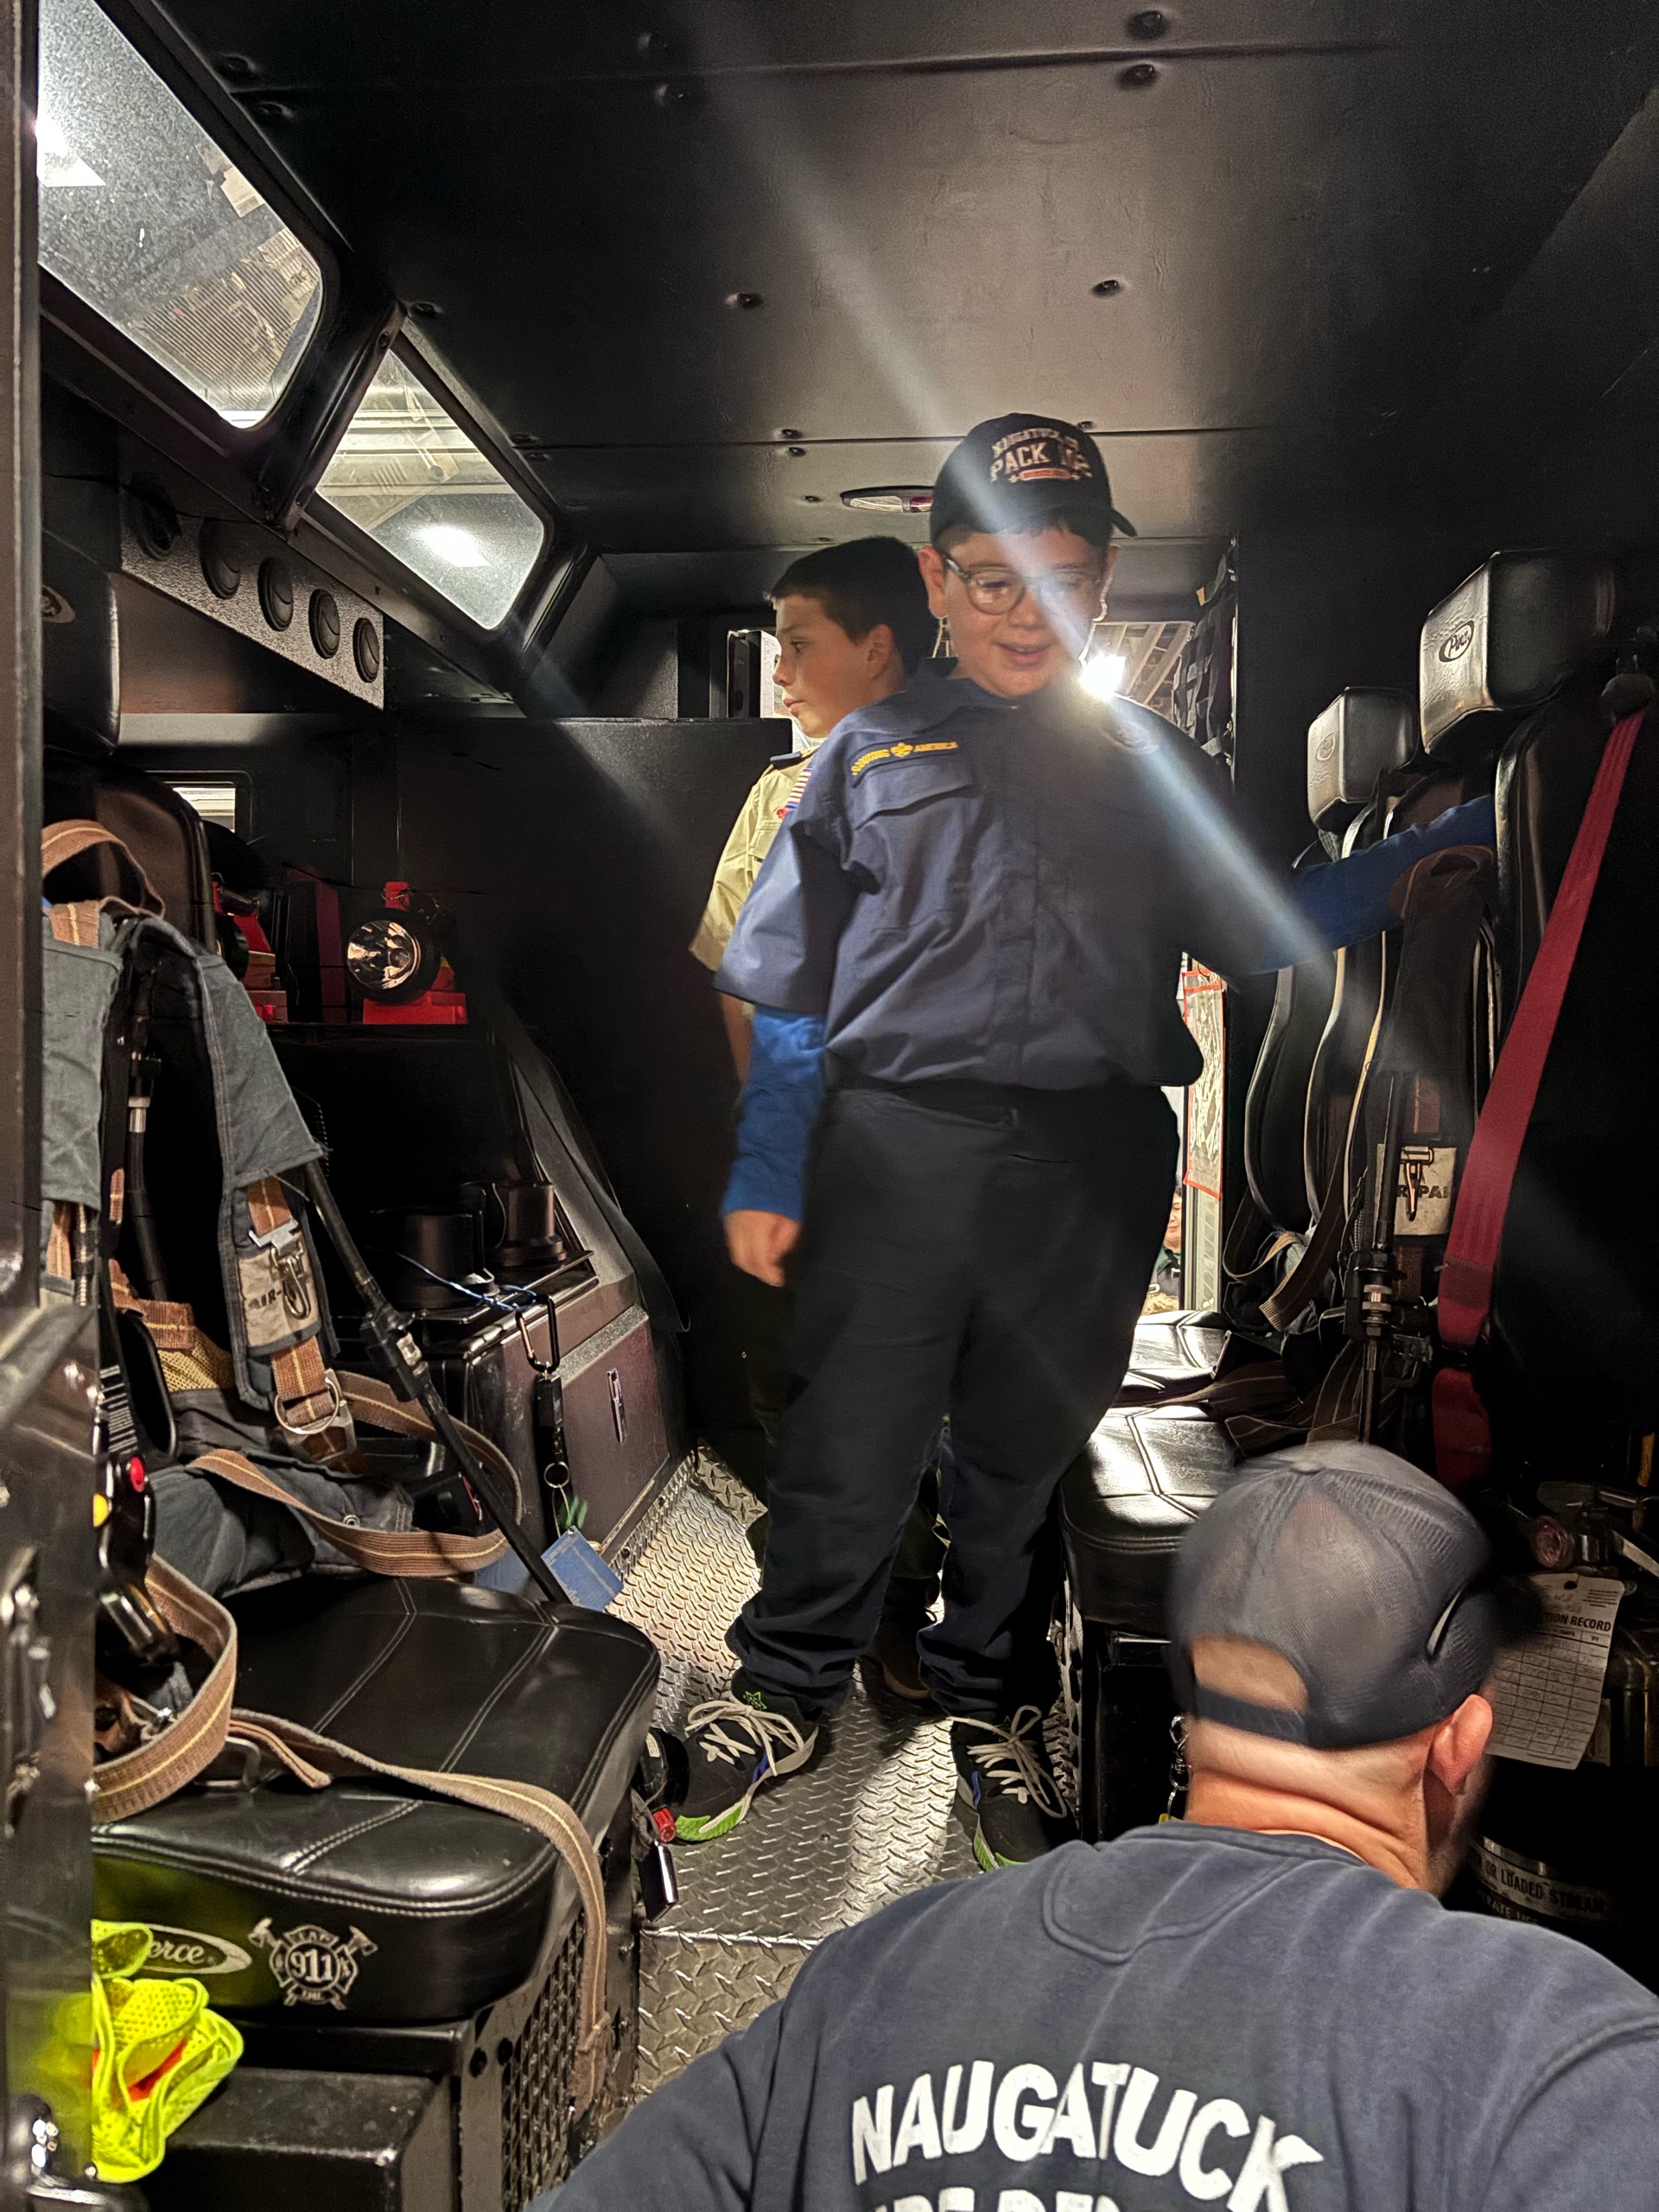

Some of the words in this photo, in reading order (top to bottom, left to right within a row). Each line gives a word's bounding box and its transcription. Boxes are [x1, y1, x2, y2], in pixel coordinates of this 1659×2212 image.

[990, 442, 1050, 482] PACK
[1570, 1616, 1611, 1632] RECORD
[1501, 1869, 1543, 1899] LOADED
[290, 1948, 334, 1982] 911
[852, 2060, 1324, 2212] NAUGATUCK
